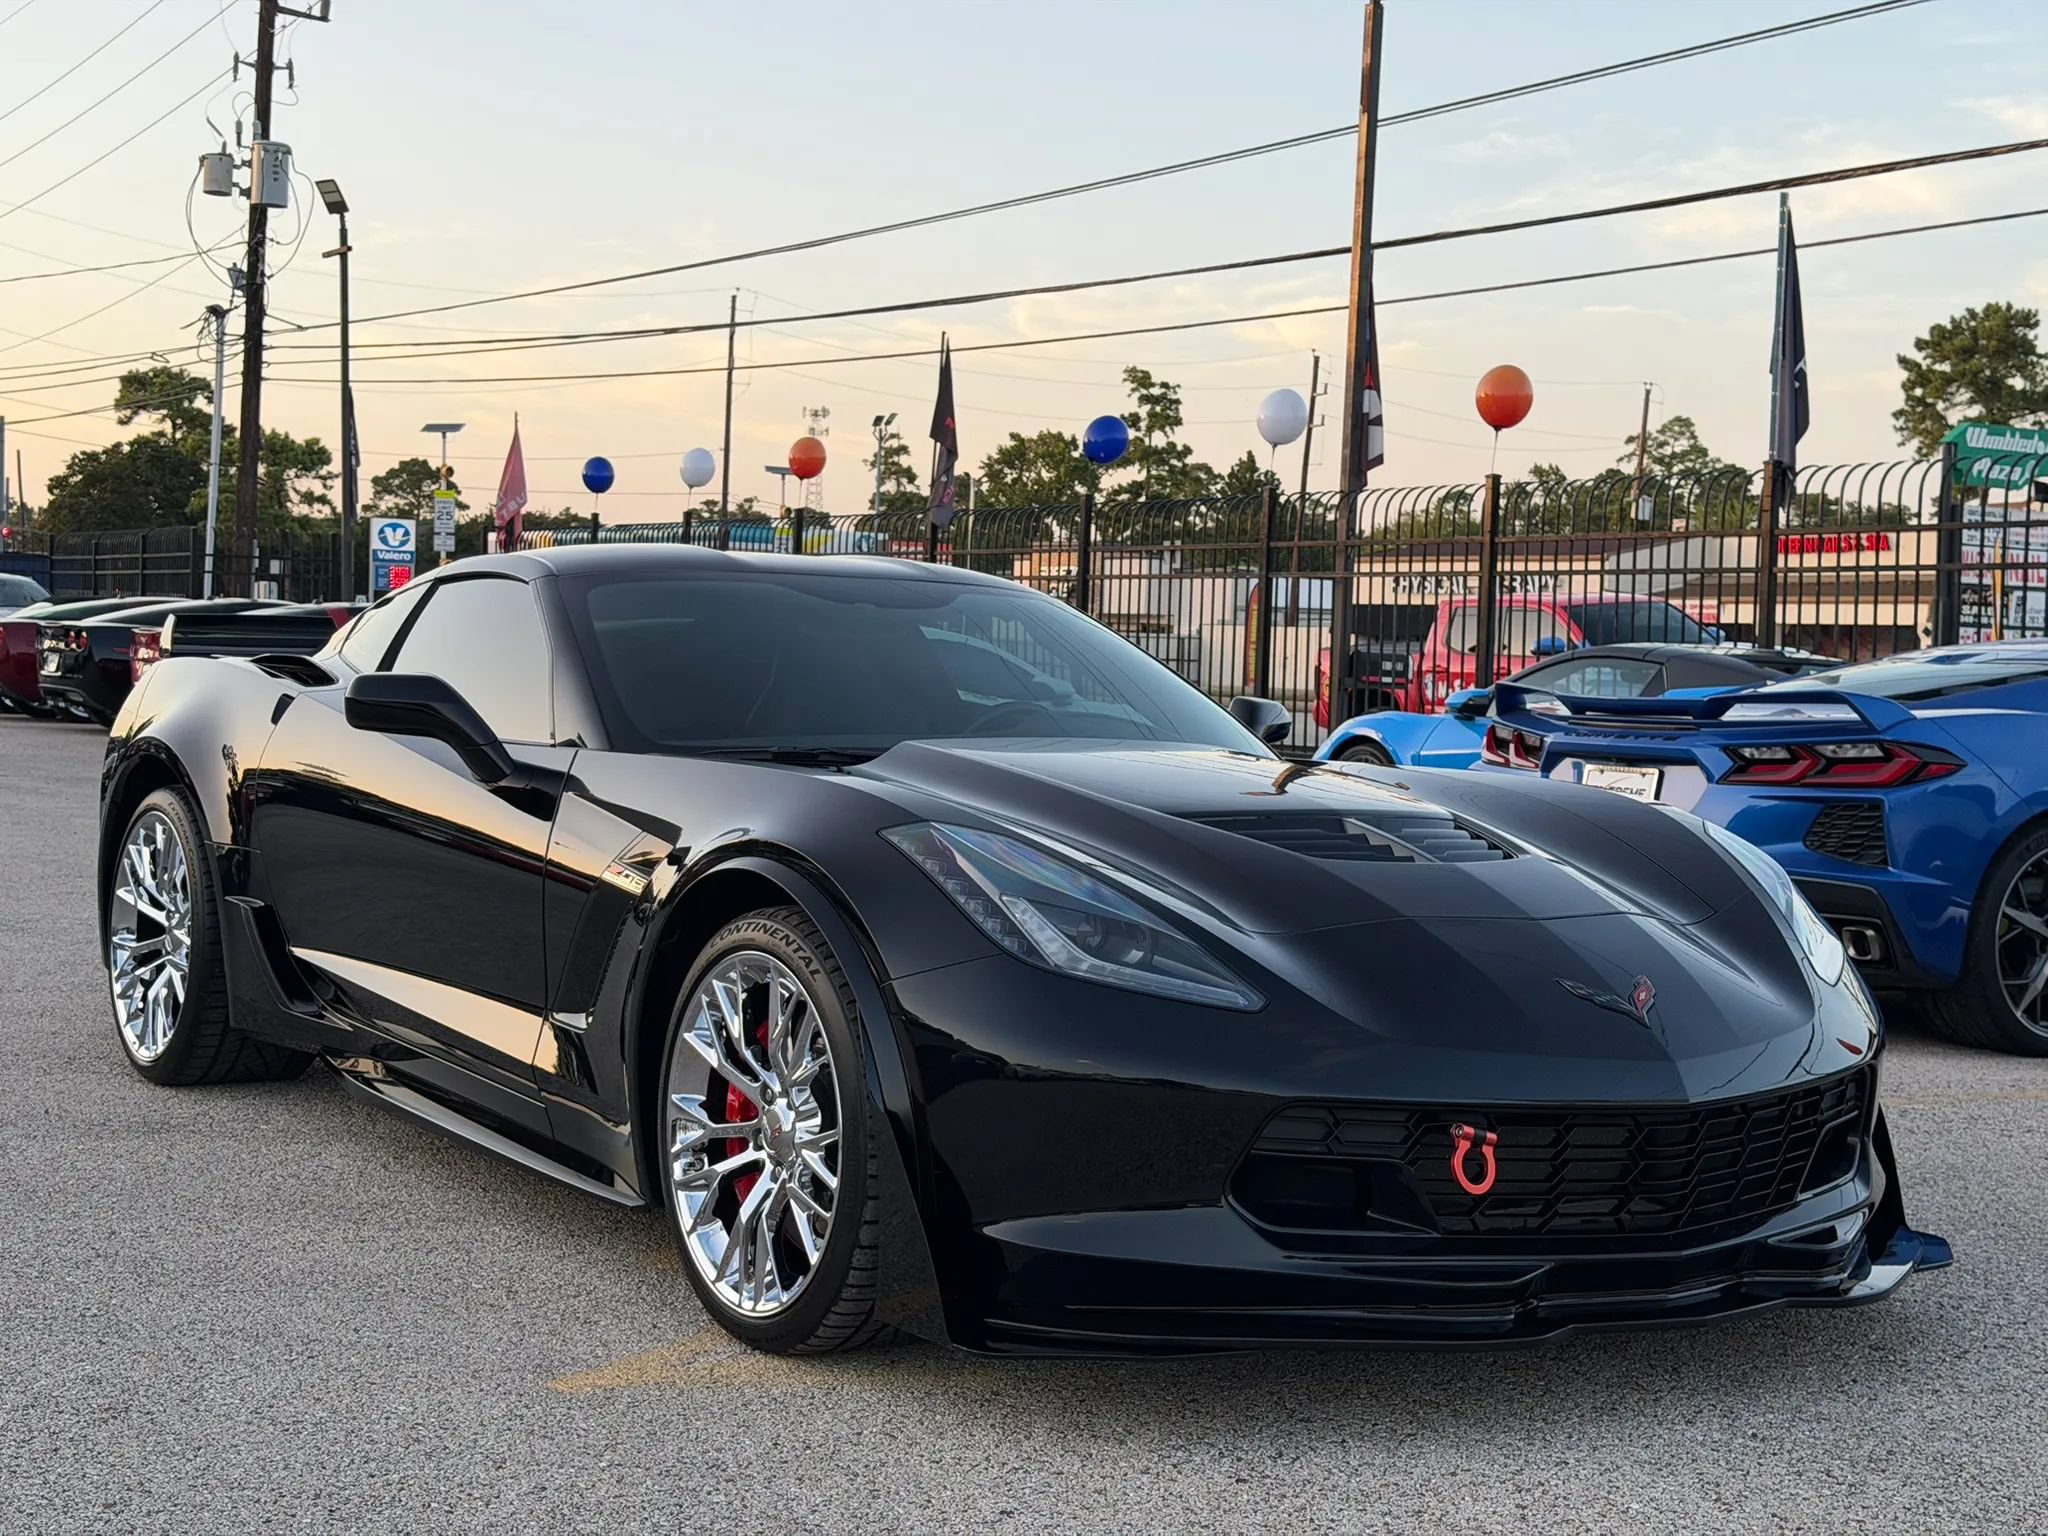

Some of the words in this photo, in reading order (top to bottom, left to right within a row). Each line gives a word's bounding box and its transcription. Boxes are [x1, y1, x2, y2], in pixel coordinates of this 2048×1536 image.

[1972, 457, 2022, 481] Plaza
[436, 510, 454, 521] 25
[377, 550, 412, 560] Valero
[2009, 552, 2045, 584] NIL
[710, 921, 822, 982] CONTINENTAL
